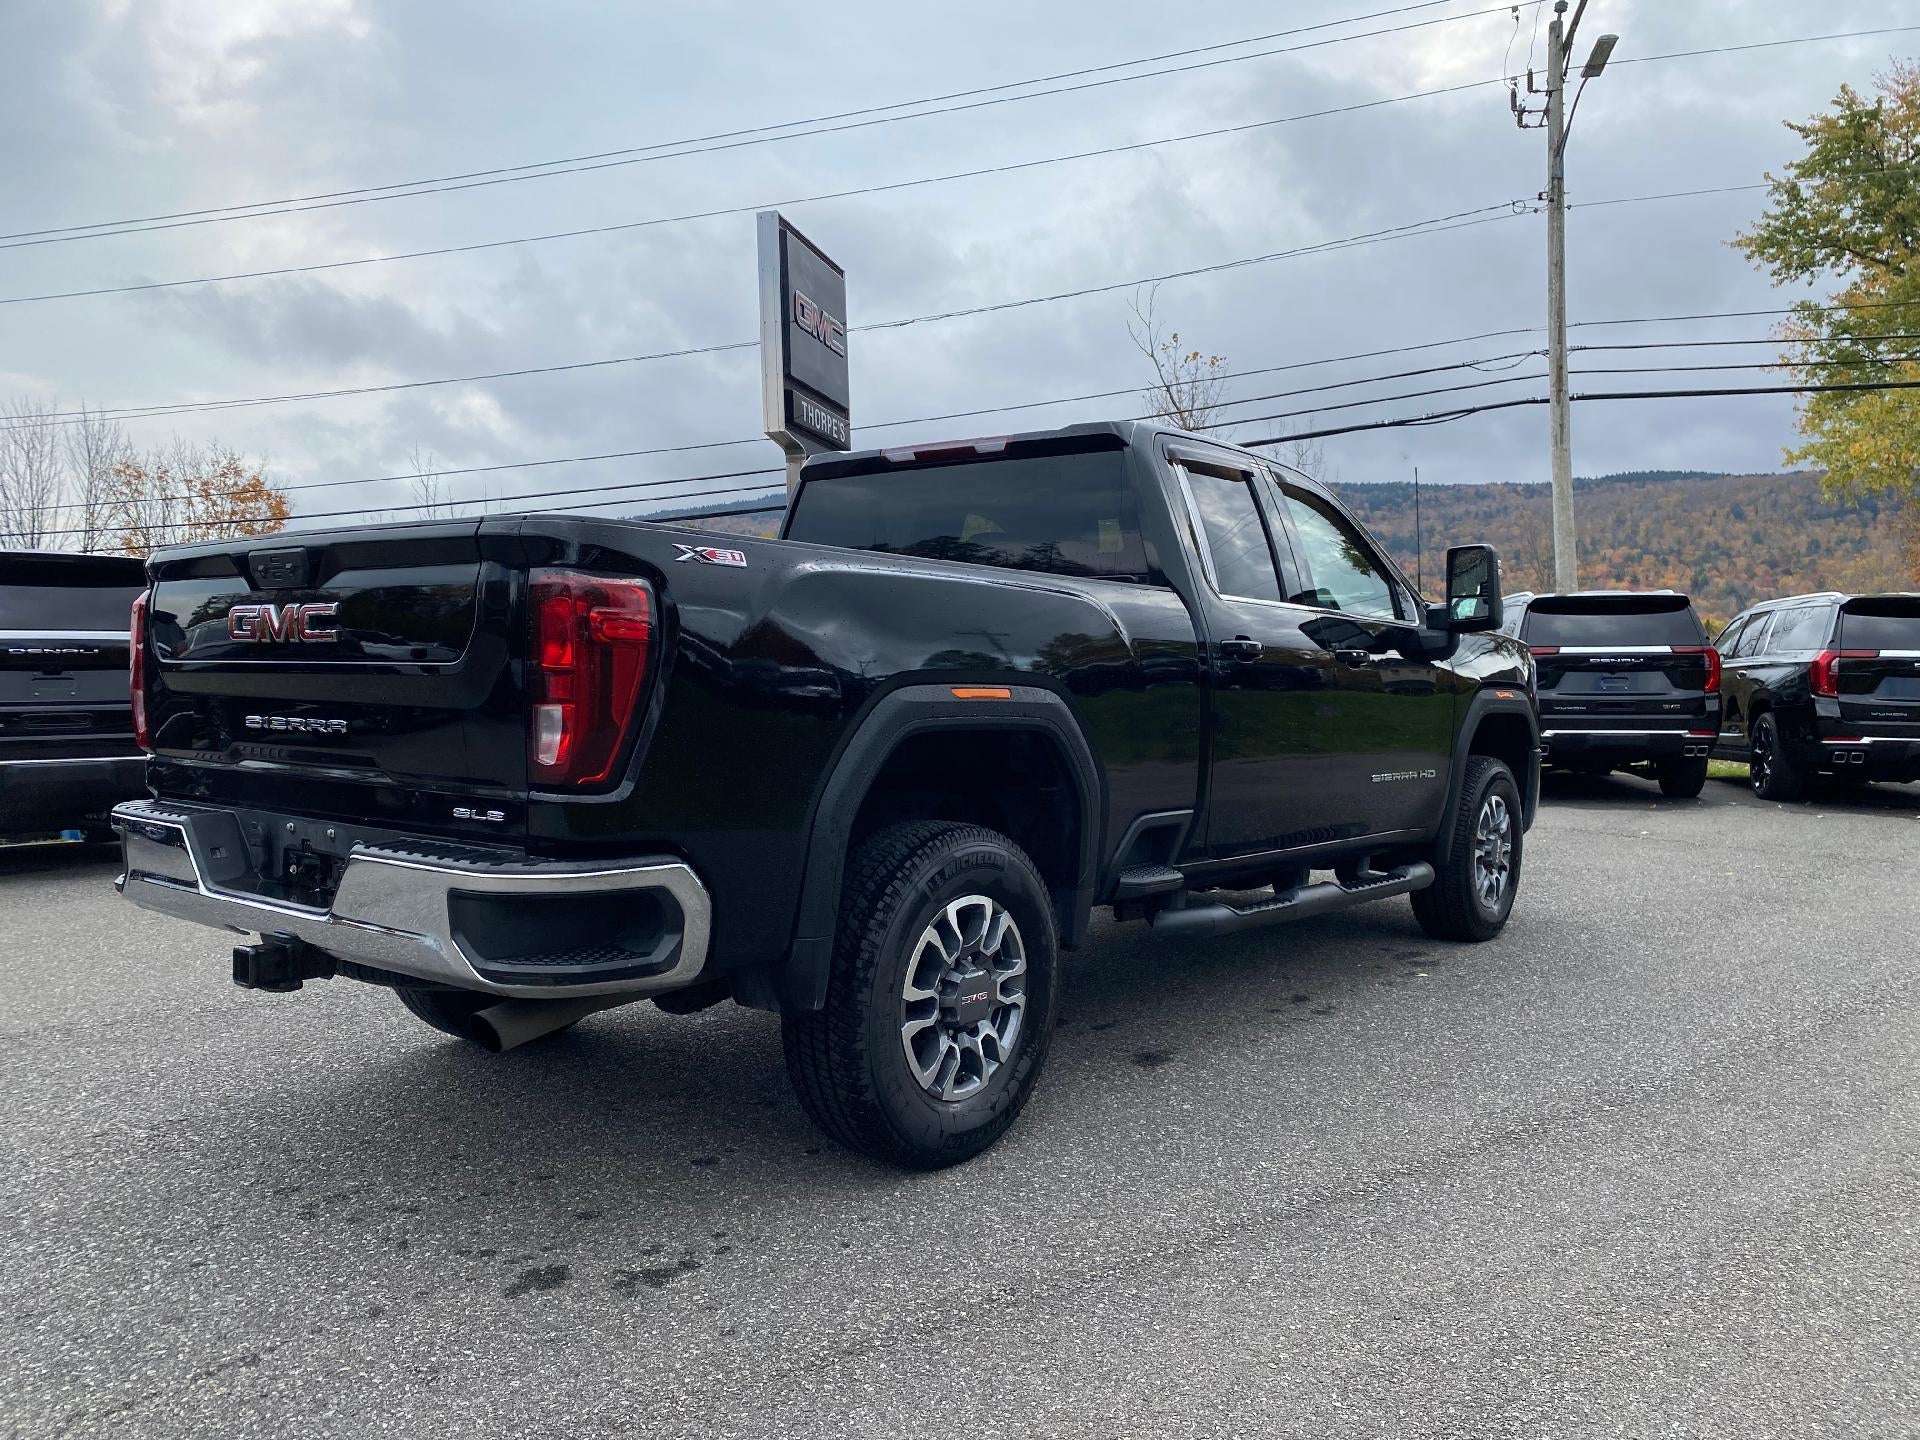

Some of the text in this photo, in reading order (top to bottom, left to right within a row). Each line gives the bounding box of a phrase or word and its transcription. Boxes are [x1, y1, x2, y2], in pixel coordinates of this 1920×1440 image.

[794, 290, 844, 358] GMC
[801, 400, 846, 443] THORPE'S
[671, 543, 748, 568] X31
[228, 602, 341, 643] GMC
[245, 715, 348, 734] SIERRA
[1371, 769, 1436, 783] SIERRA HD
[452, 807, 505, 821] SLE
